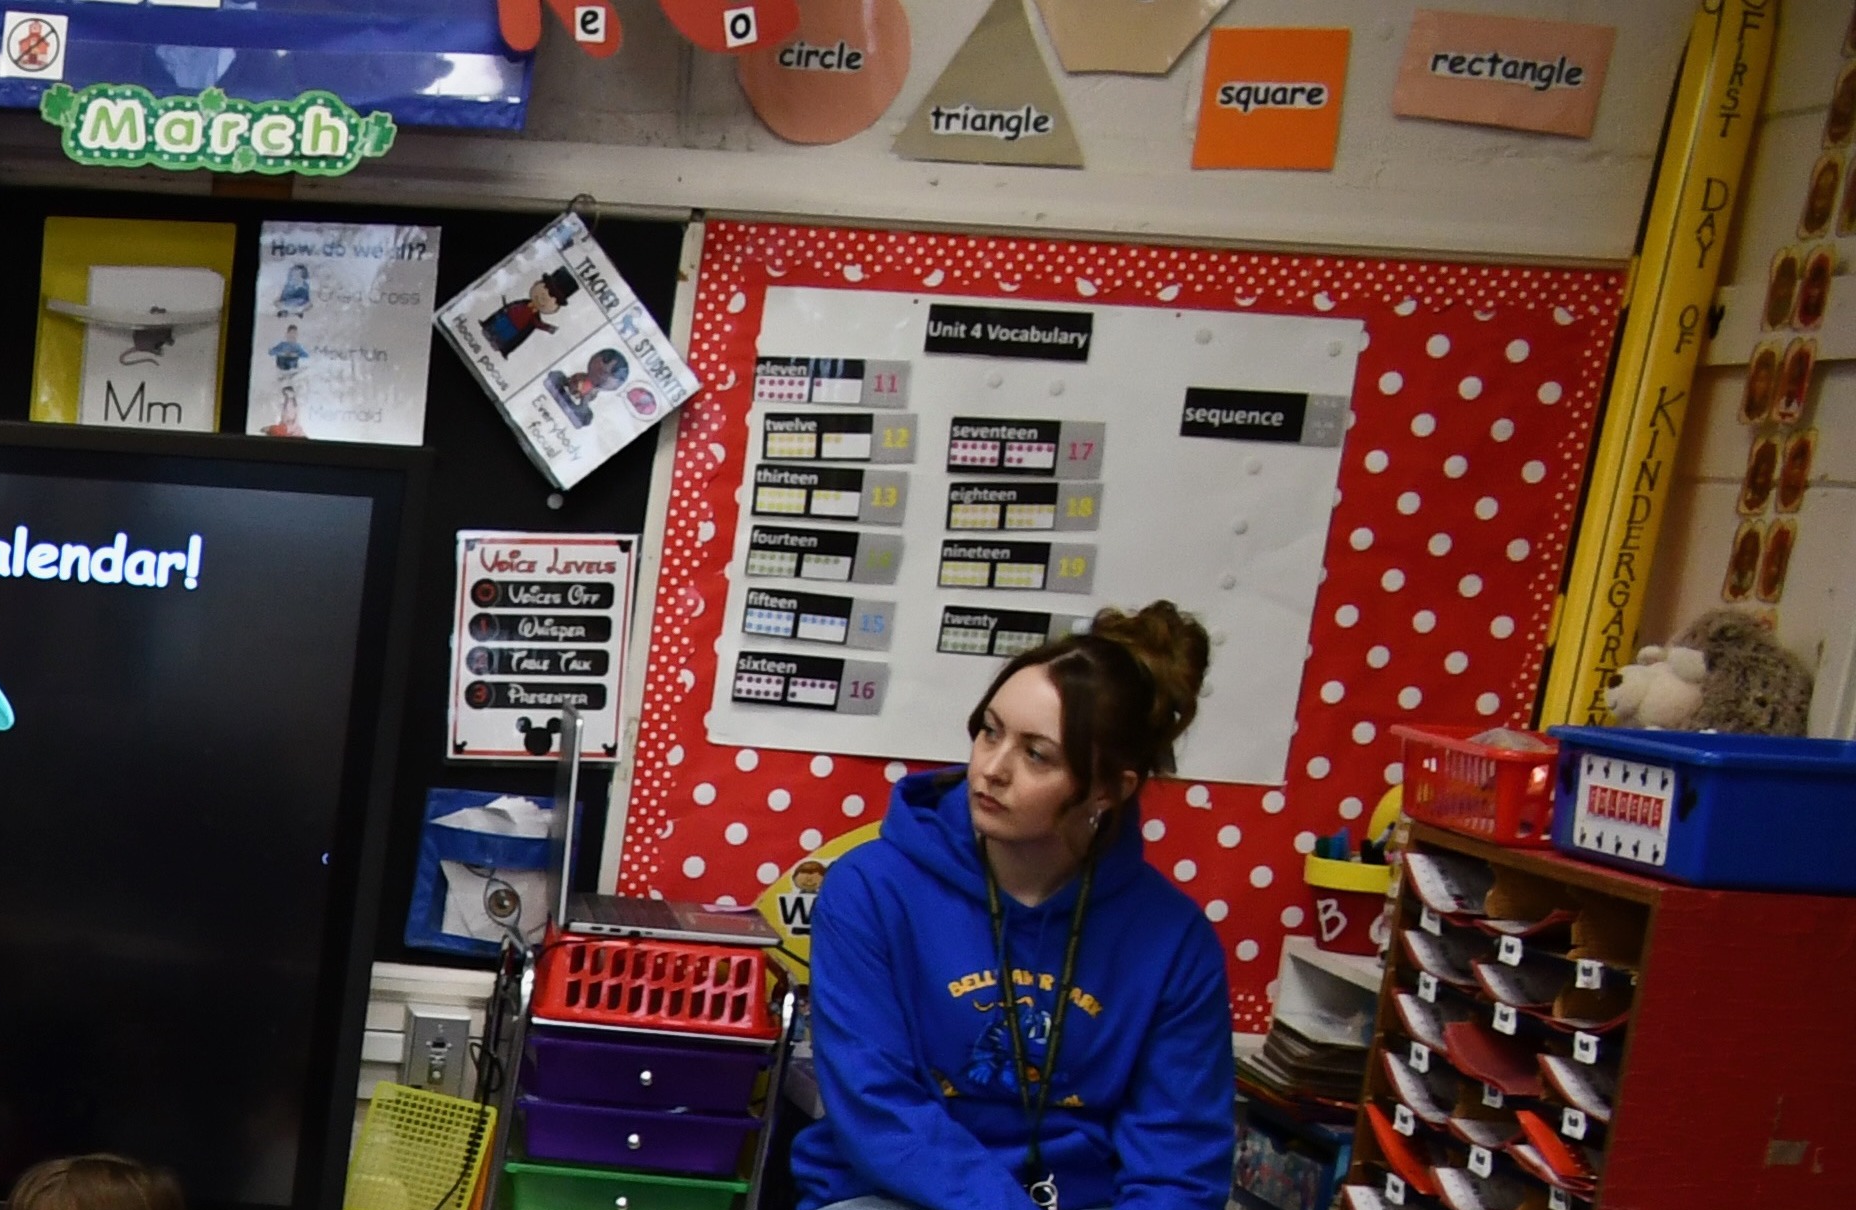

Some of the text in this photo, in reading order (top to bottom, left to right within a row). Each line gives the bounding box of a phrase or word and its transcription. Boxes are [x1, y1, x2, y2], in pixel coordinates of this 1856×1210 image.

[778, 41, 863, 71] circle
[1431, 50, 1583, 91] rectangle
[1720, 12, 1765, 138] FIRST
[1219, 81, 1324, 112] square
[80, 98, 350, 156] March
[931, 104, 1050, 141] triangle
[1695, 177, 1729, 269] DAY
[271, 240, 385, 259] How do we
[576, 256, 620, 312] TEACHER
[928, 320, 1088, 348] Unit 4 Vocabulary
[453, 315, 509, 391] Hocus pocus
[635, 338, 687, 404] STUDENTS
[755, 363, 898, 394] eleven 11
[104, 382, 182, 424] Mm
[1185, 406, 1284, 428] sequence
[532, 394, 581, 462] Everybody
[765, 418, 909, 448] twelve 12
[952, 425, 1094, 460] seventeen 17
[756, 469, 898, 507] thirteen 13
[950, 488, 1017, 504] eighteen
[751, 530, 818, 547] fourteen
[943, 544, 1087, 578] nineteen 19
[747, 591, 885, 634] fifteen 15
[943, 613, 998, 630] twenty
[738, 657, 875, 700] sixteen 16
